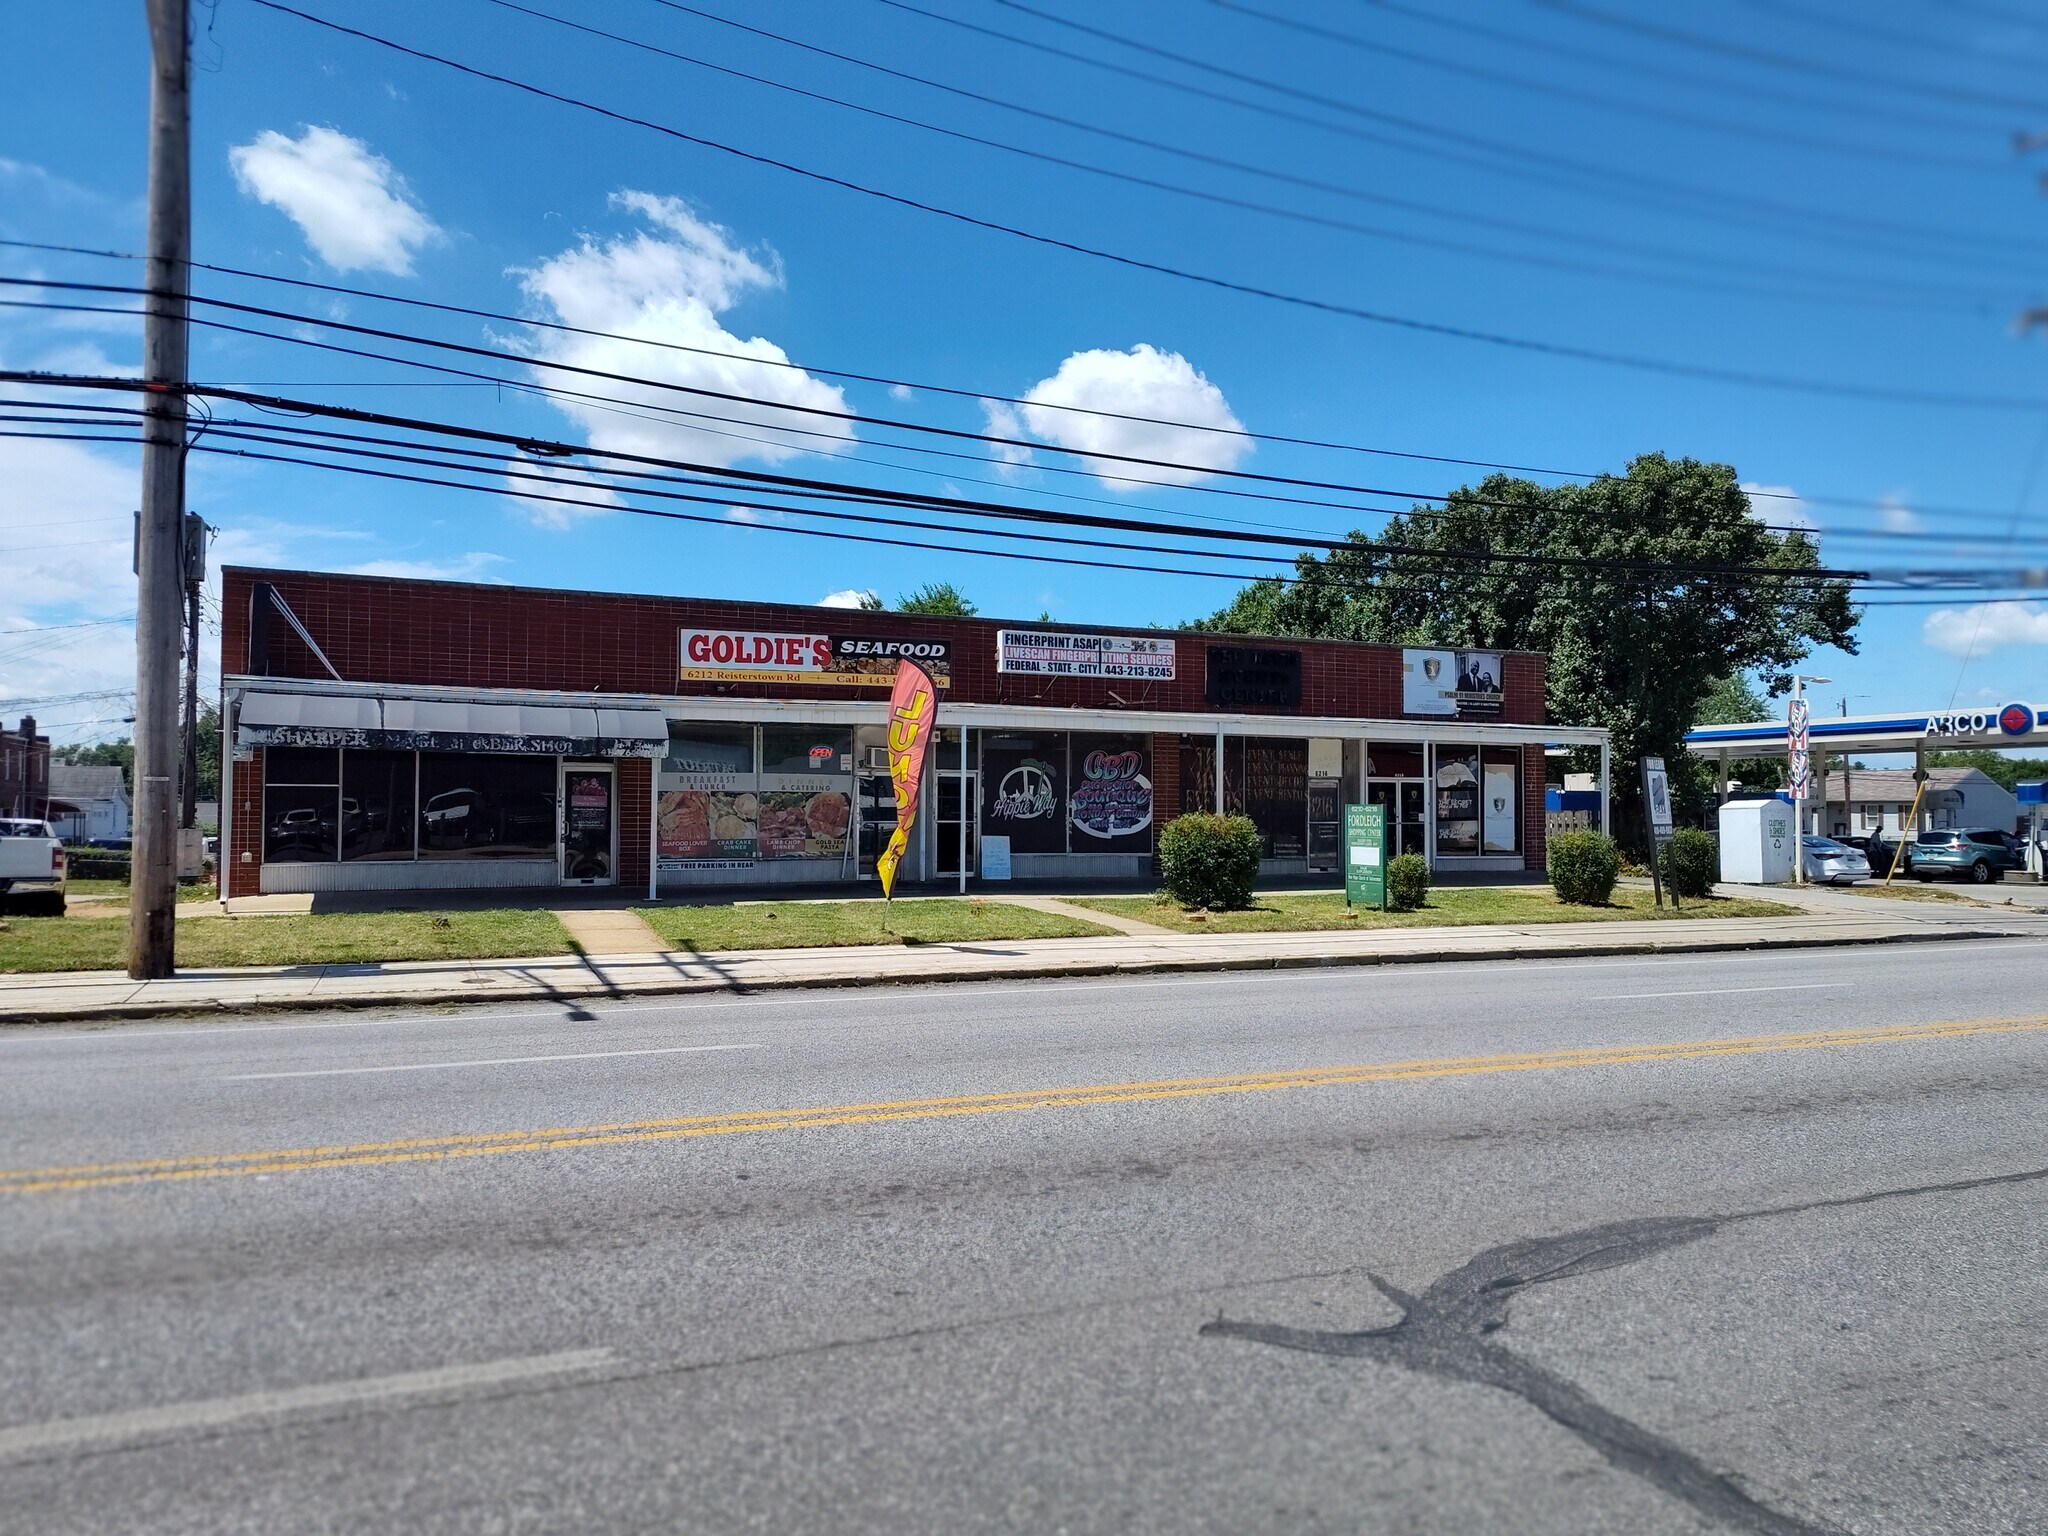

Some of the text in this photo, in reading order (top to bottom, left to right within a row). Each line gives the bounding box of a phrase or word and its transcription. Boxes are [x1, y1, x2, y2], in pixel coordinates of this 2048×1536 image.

[840, 640, 946, 656] SEAFOOD
[1005, 634, 1071, 648] FINGERPRINT
[1073, 638, 1099, 650] ASAP
[688, 634, 832, 667] GOLDIE'S
[1005, 647, 1172, 666] LIVESCAN FINGERPRINTING SERVICES
[1006, 660, 1040, 672] FEDERAL
[1048, 662, 1071, 673] STATE
[1079, 664, 1097, 674] CITY
[1105, 665, 1172, 677] 443-213-8245
[688, 670, 712, 679] 6212
[717, 672, 783, 681] Reisterstown
[836, 675, 862, 684] Call:
[1924, 713, 1987, 733] ARCO
[810, 749, 832, 757] OPEN
[1084, 750, 1142, 780] CBD
[991, 793, 1058, 820] Hippie Way
[1348, 815, 1381, 827] FORDLEIGH
